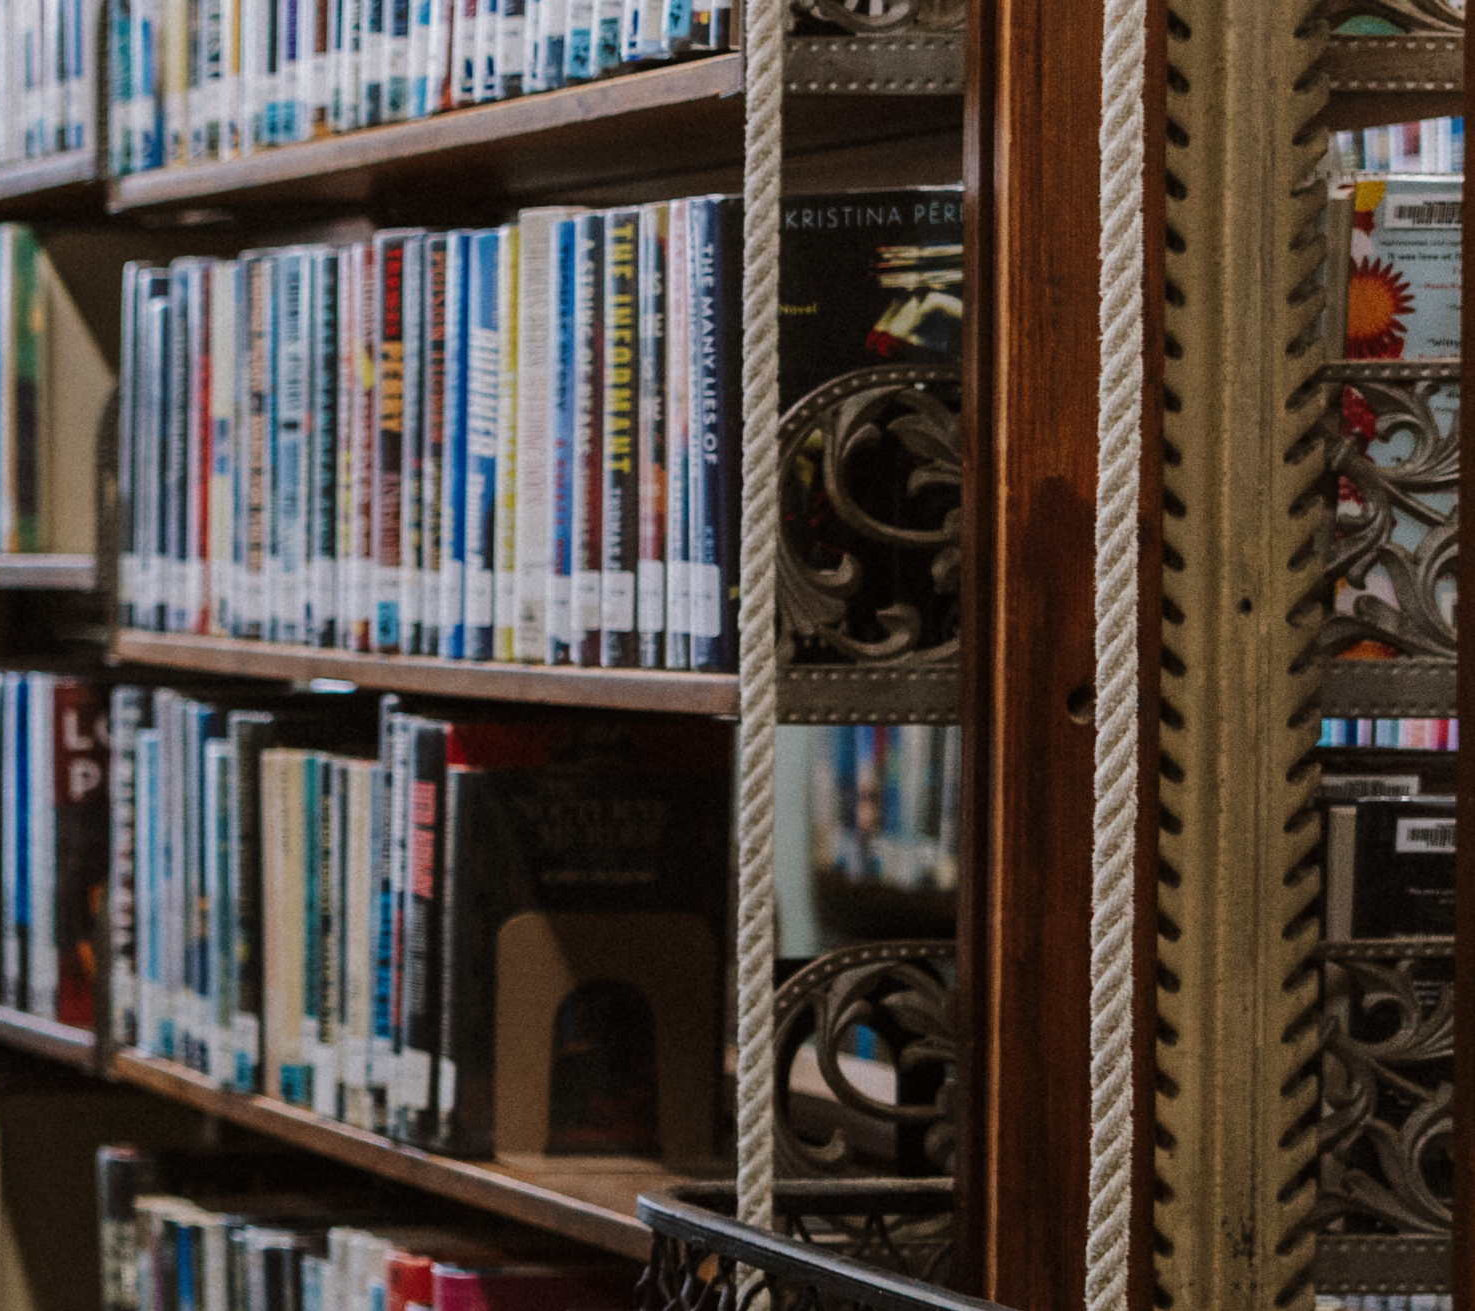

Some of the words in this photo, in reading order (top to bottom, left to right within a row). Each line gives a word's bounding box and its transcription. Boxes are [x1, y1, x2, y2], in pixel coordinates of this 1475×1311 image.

[784, 205, 903, 230] KRISTINA
[913, 200, 964, 226] PÉR
[607, 222, 635, 280] THE
[700, 242, 716, 288] THE
[700, 294, 716, 368] MANY
[380, 342, 405, 434] PERRY
[605, 291, 633, 476] INFORMANT
[701, 375, 717, 425] LIES
[702, 430, 718, 464] OF
